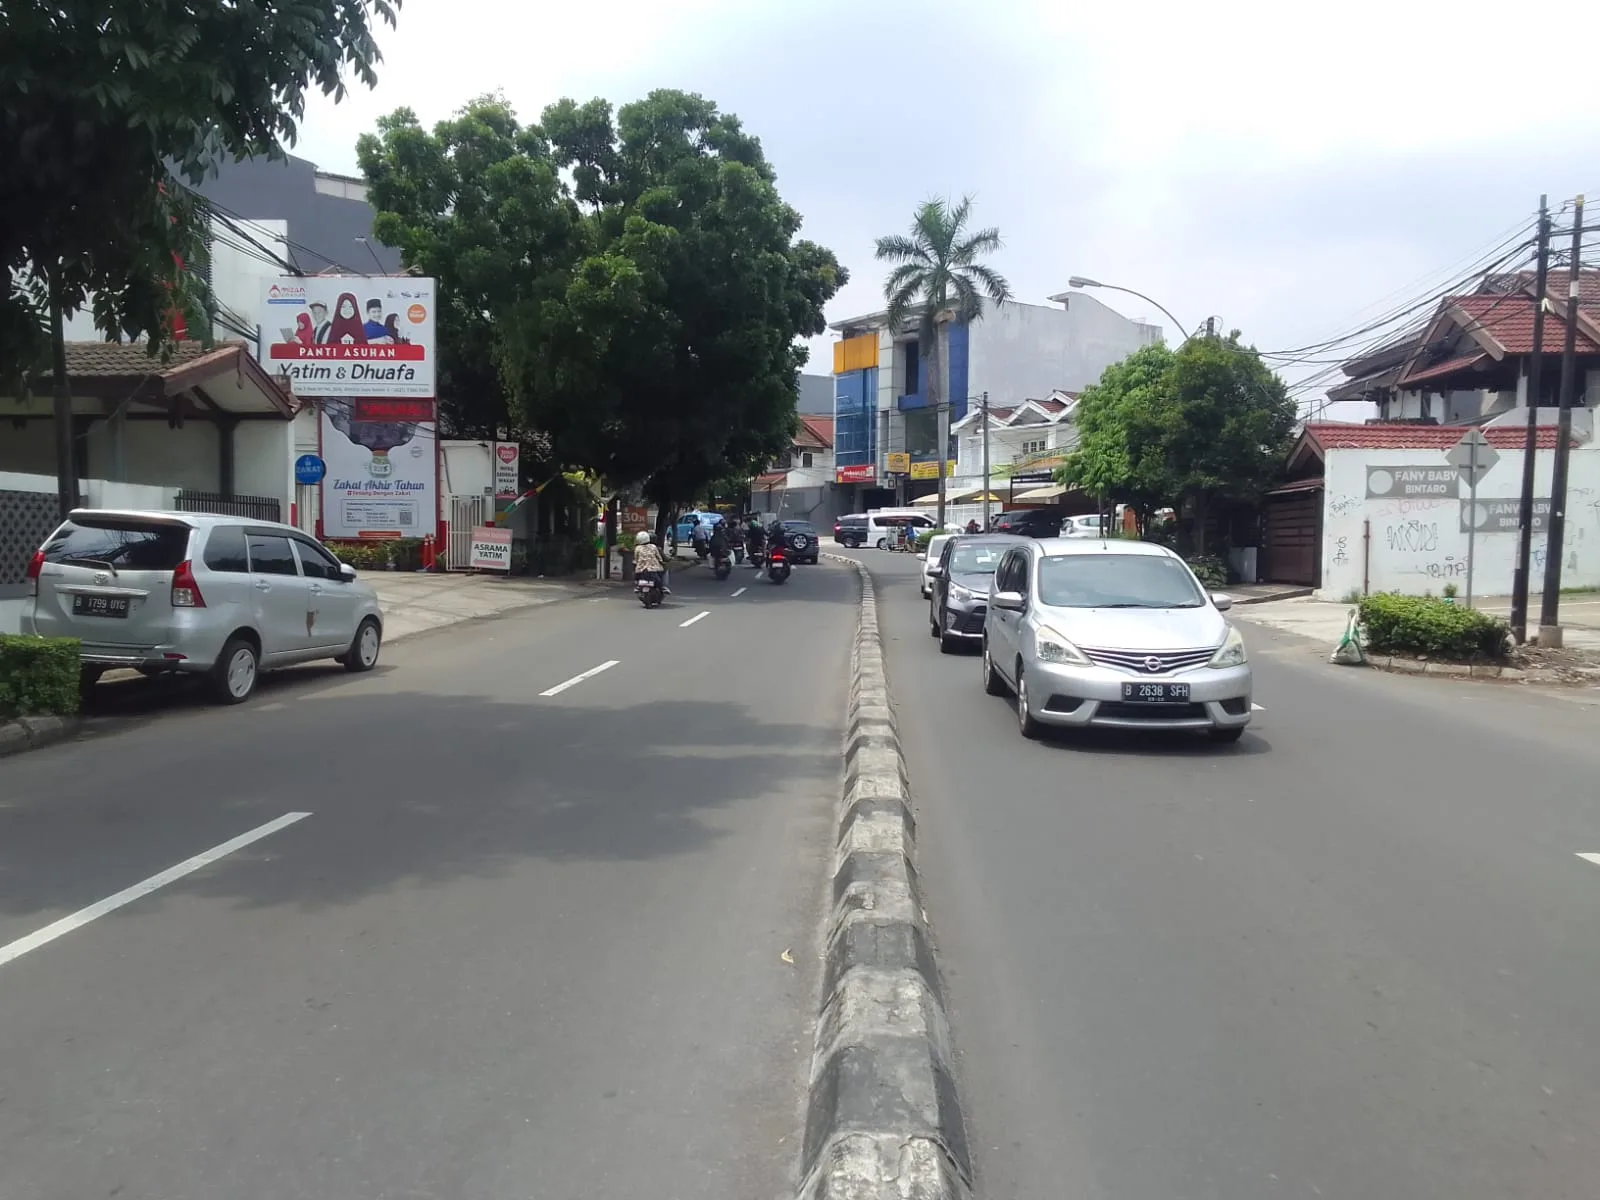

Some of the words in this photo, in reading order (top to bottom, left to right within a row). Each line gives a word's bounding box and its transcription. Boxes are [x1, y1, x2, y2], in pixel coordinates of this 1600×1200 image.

[299, 347, 337, 357] PANTI
[344, 347, 396, 357] ASUHAN
[280, 363, 331, 380] Yatim
[336, 367, 346, 379] &
[351, 363, 415, 380] Dhuafa
[1395, 470, 1425, 481] FANY
[1427, 470, 1458, 481] BABY
[333, 479, 362, 490] Zakat
[364, 479, 393, 490] Akhir
[394, 480, 425, 490] Tahun
[1405, 484, 1447, 494] BINTARO
[1499, 517, 1541, 527] BINTO
[474, 543, 508, 553] ASRAMA
[478, 551, 503, 560] YATIM
[75, 596, 82, 607] B
[88, 598, 107, 609] 1799
[1125, 684, 1132, 696] B
[1139, 684, 1164, 697] 2638
[1170, 685, 1188, 697] SFH
